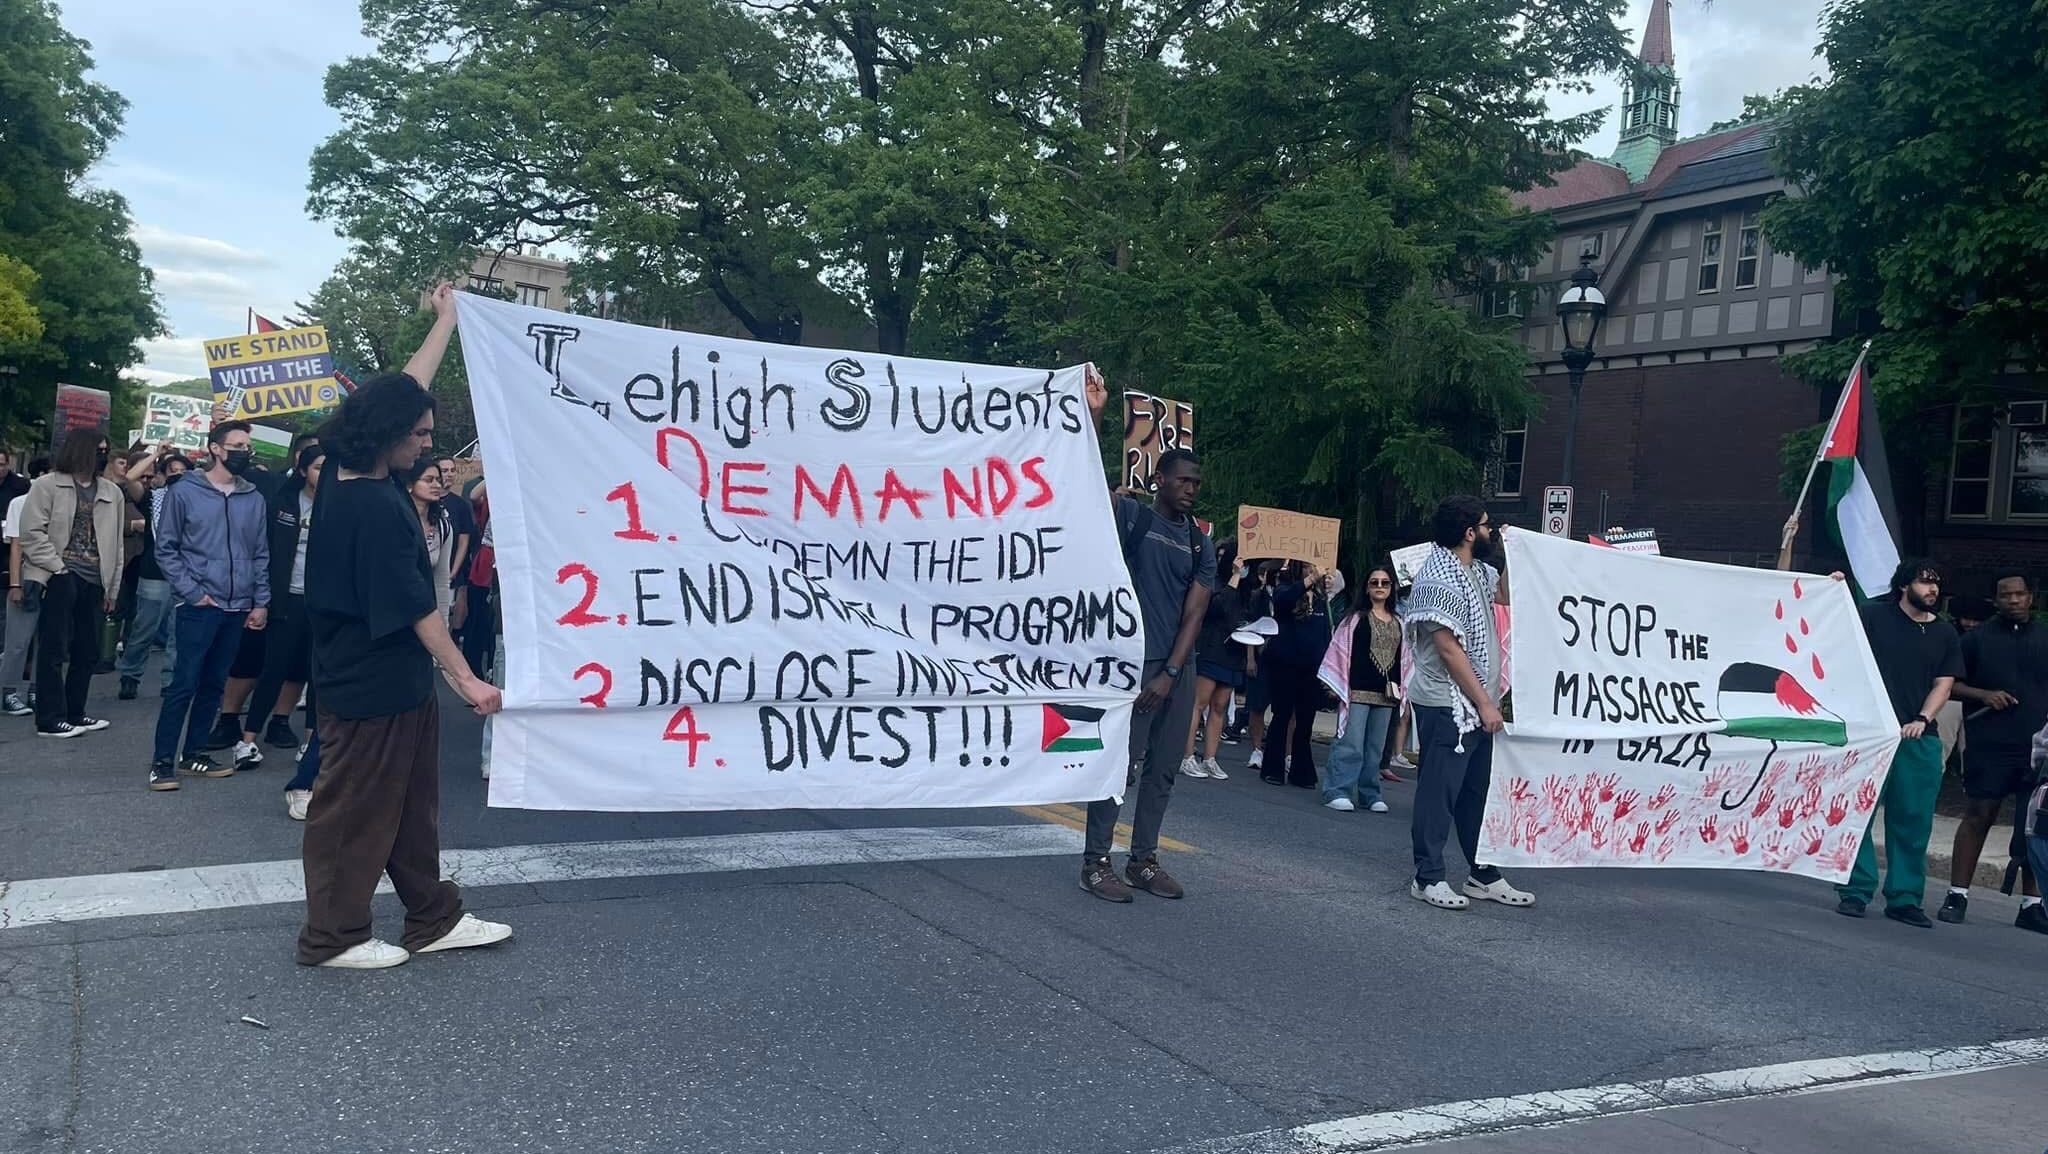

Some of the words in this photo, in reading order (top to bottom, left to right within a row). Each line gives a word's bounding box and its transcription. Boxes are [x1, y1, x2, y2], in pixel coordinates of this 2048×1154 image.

[207, 342, 243, 361] WE
[249, 332, 323, 356] STAND
[219, 364, 275, 388] WITH
[281, 358, 324, 379] THE
[526, 322, 795, 449] Lehigh
[241, 384, 312, 415] UAW
[656, 426, 1054, 527] DEMANDS
[606, 481, 678, 542] 1.
[701, 499, 892, 582] CDEMN
[903, 536, 984, 584] THE
[998, 527, 1064, 583] IDF
[1245, 532, 1333, 559] PALESTINE
[1267, 512, 1297, 529] FREE
[1605, 530, 1655, 542] PERMANENT
[556, 562, 628, 626] 2.
[630, 562, 754, 627] END
[931, 586, 1138, 646] PROGRAMS
[1558, 595, 1657, 658] STOP
[1664, 628, 1709, 661] THE
[896, 650, 1139, 697] INVESTMENTS
[1552, 670, 1722, 724] MASSACRE
[662, 705, 727, 768] 4.
[759, 704, 1013, 773] DIVEST!!!
